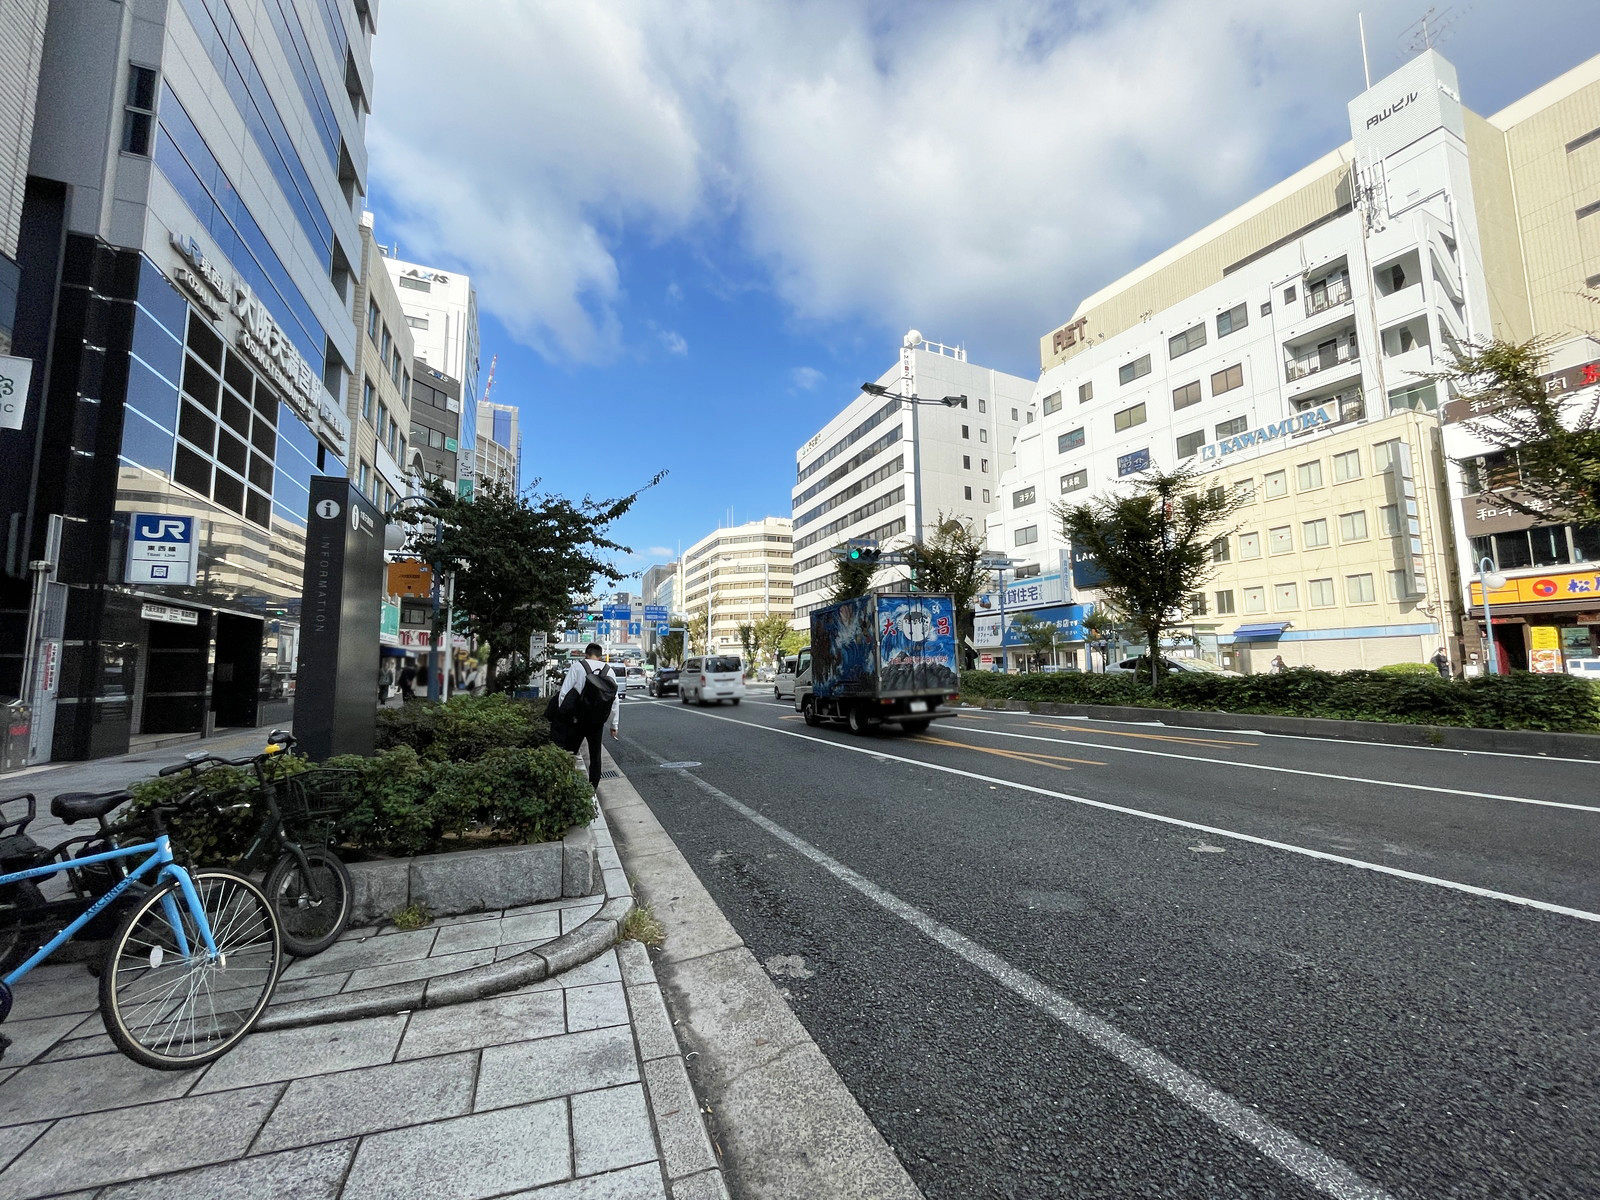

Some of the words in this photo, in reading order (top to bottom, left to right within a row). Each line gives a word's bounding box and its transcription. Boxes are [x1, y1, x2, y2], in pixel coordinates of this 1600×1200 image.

[1366, 91, 1418, 130] 円山ビル
[406, 269, 449, 284] AXIS
[428, 369, 449, 383] AXIS
[1219, 407, 1331, 456] KAWAMURA
[142, 520, 185, 540] JR
[315, 536, 331, 632] INFORMATION
[85, 876, 133, 917] ARCHNESS
